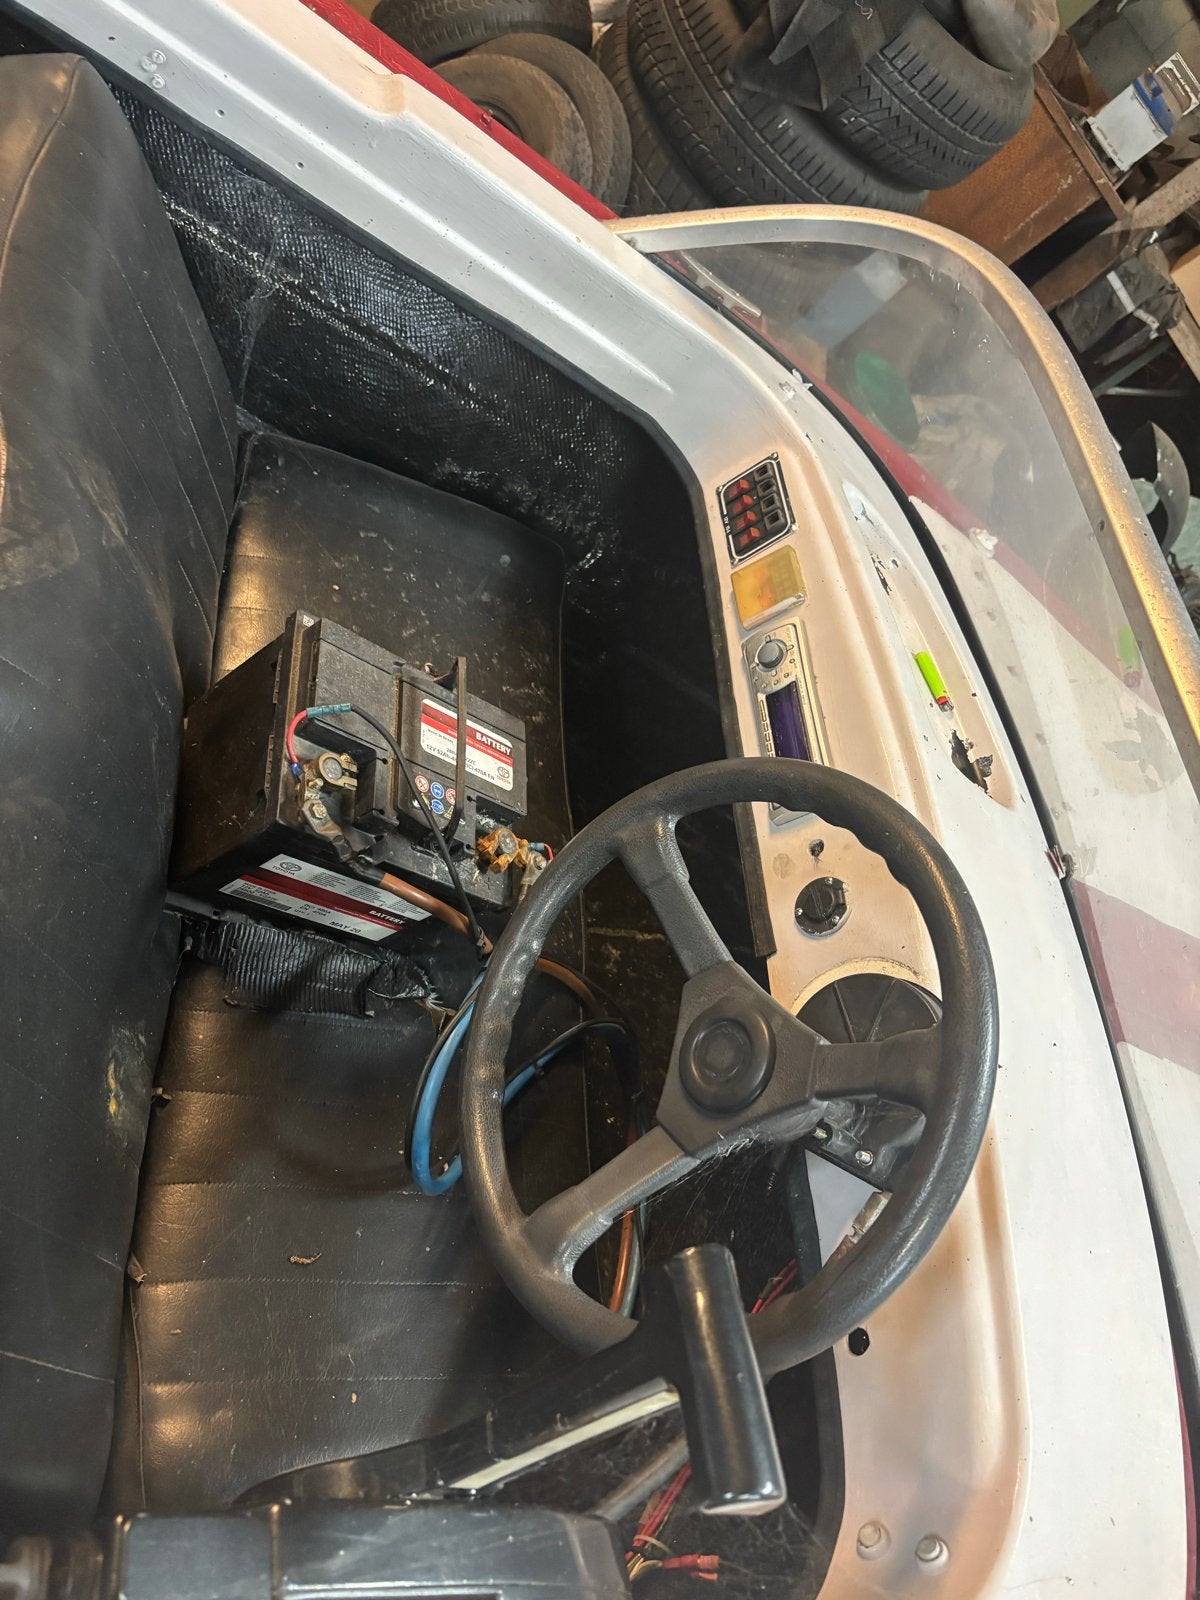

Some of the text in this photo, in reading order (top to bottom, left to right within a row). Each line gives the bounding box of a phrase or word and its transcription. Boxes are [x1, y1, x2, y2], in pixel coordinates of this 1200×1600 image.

[475, 731, 511, 755] BATTERY
[272, 865, 295, 876] TOYOTA
[368, 910, 407, 925] BATTERY
[329, 920, 362, 934] MAY 20
